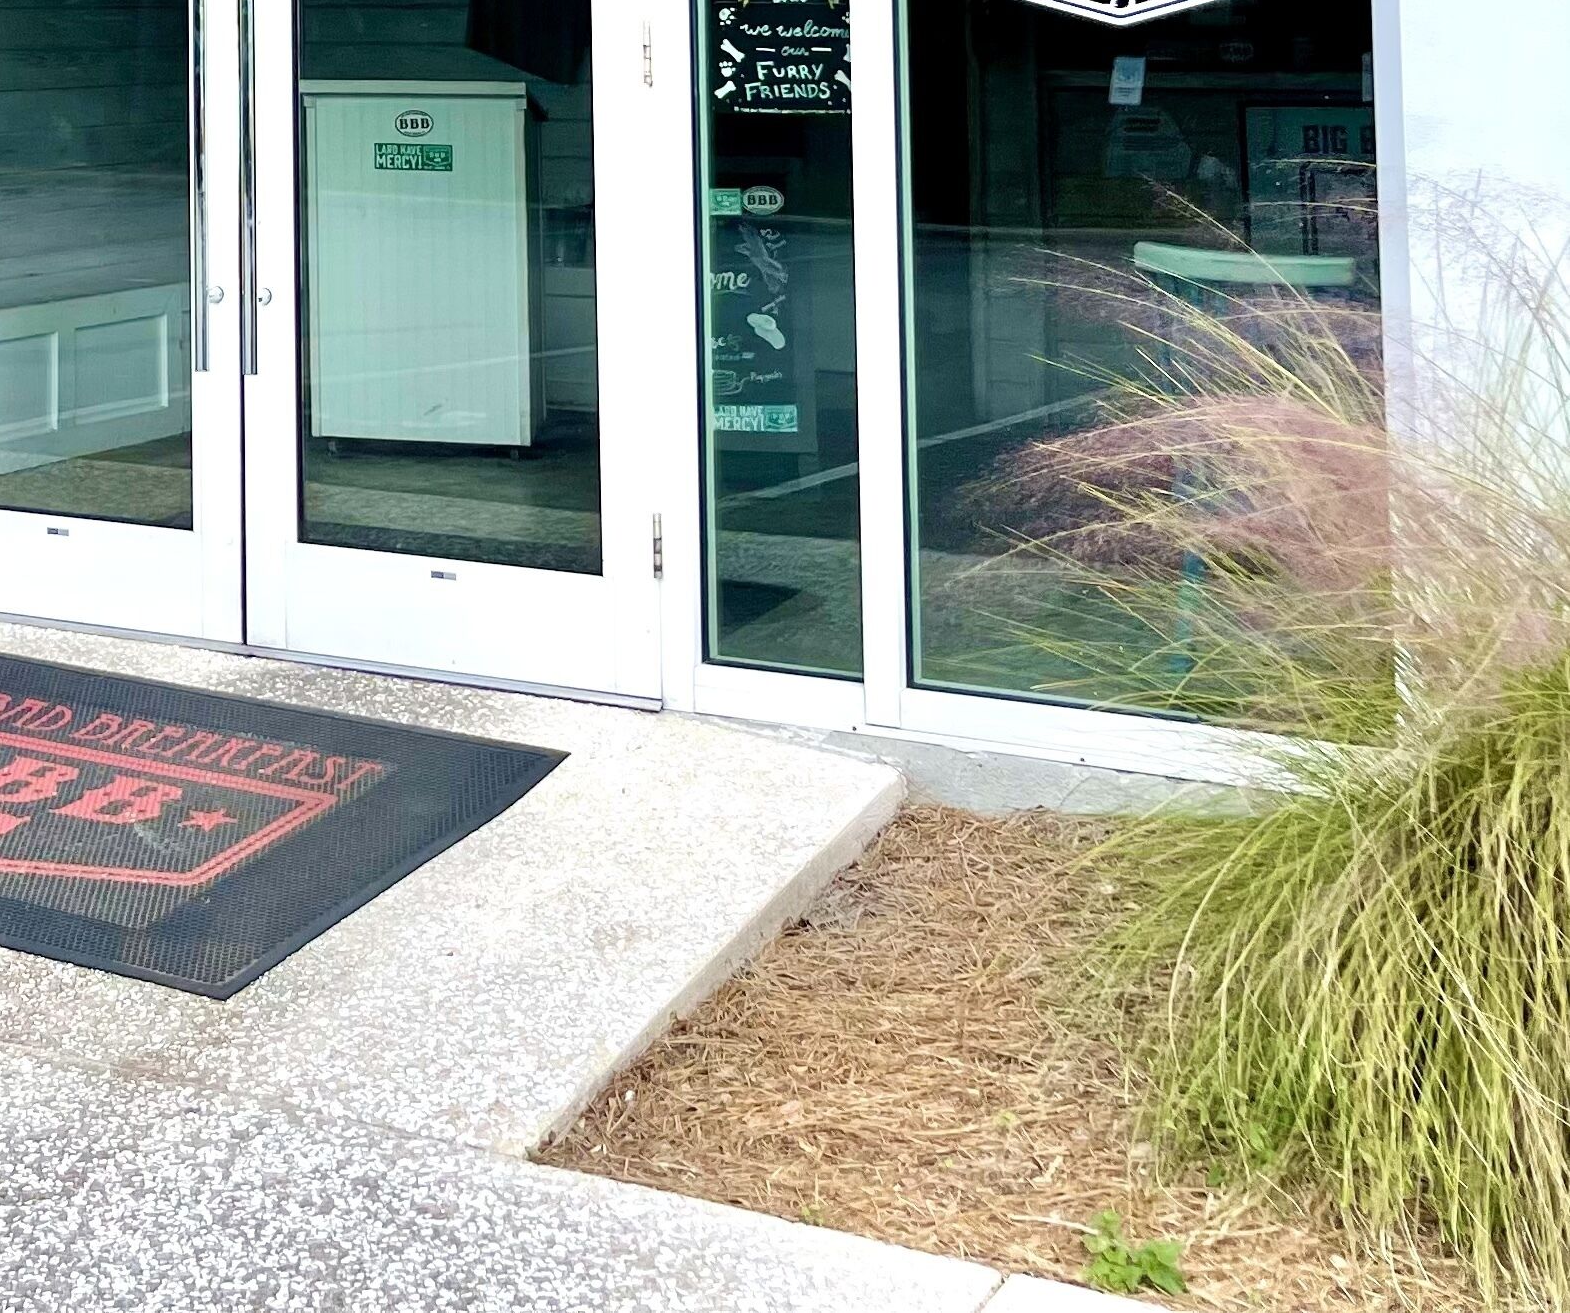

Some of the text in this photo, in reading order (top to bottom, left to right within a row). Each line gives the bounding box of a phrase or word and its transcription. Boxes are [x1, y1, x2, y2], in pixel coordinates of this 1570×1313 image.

[740, 23, 772, 36] we
[780, 45, 810, 56] our
[756, 60, 824, 81] FURRY
[744, 81, 831, 102] FRIENDS
[399, 118, 430, 129] BBB
[1302, 124, 1348, 154] BIG
[376, 155, 422, 169] MERCY!
[747, 194, 779, 206] BBB
[712, 406, 737, 416] ARD
